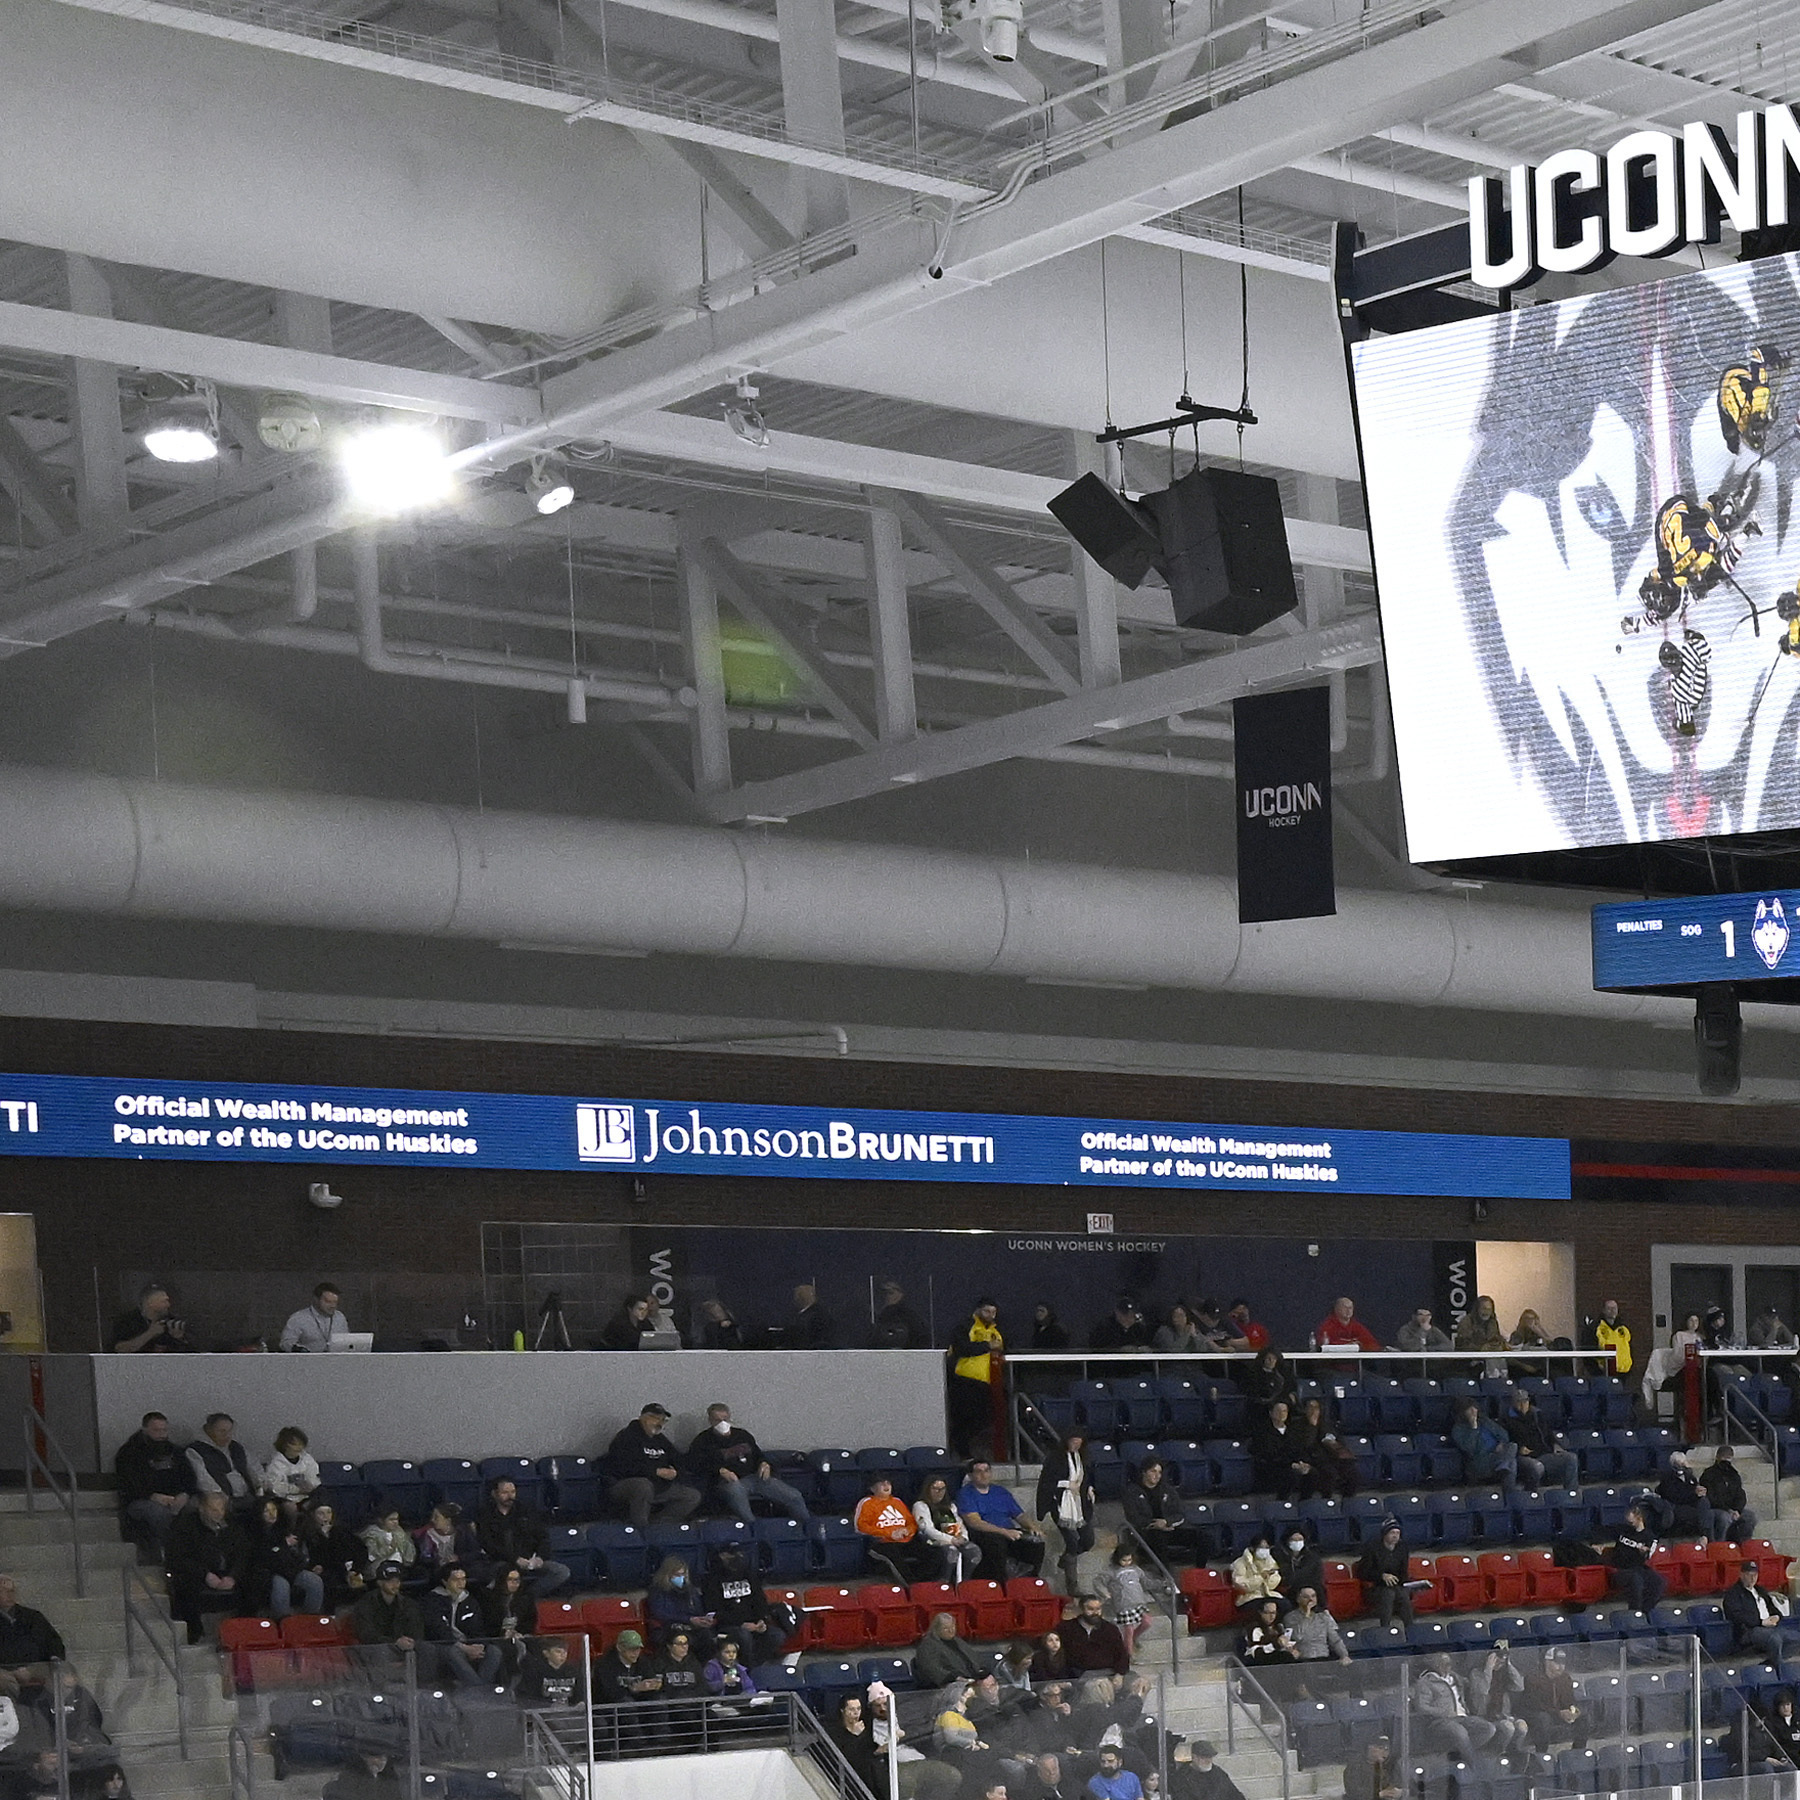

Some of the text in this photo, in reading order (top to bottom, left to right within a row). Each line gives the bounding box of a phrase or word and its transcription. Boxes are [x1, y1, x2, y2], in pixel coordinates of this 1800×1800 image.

[1245, 781, 1322, 818] UCONN
[1269, 815, 1301, 828] HOCKEY
[1617, 919, 1662, 933] PENALTIES
[1680, 924, 1702, 936] SOG
[1720, 920, 1736, 958] 1
[114, 1095, 469, 1129] Official Wealth Management
[113, 1123, 478, 1156] Partner of the UConn Huskies
[1081, 1132, 1331, 1161] Official Wealth Management
[1080, 1157, 1338, 1182] Partner of the UConn Huskies
[1008, 1239, 1166, 1252] UCONN WOMEN'S HOCKEY
